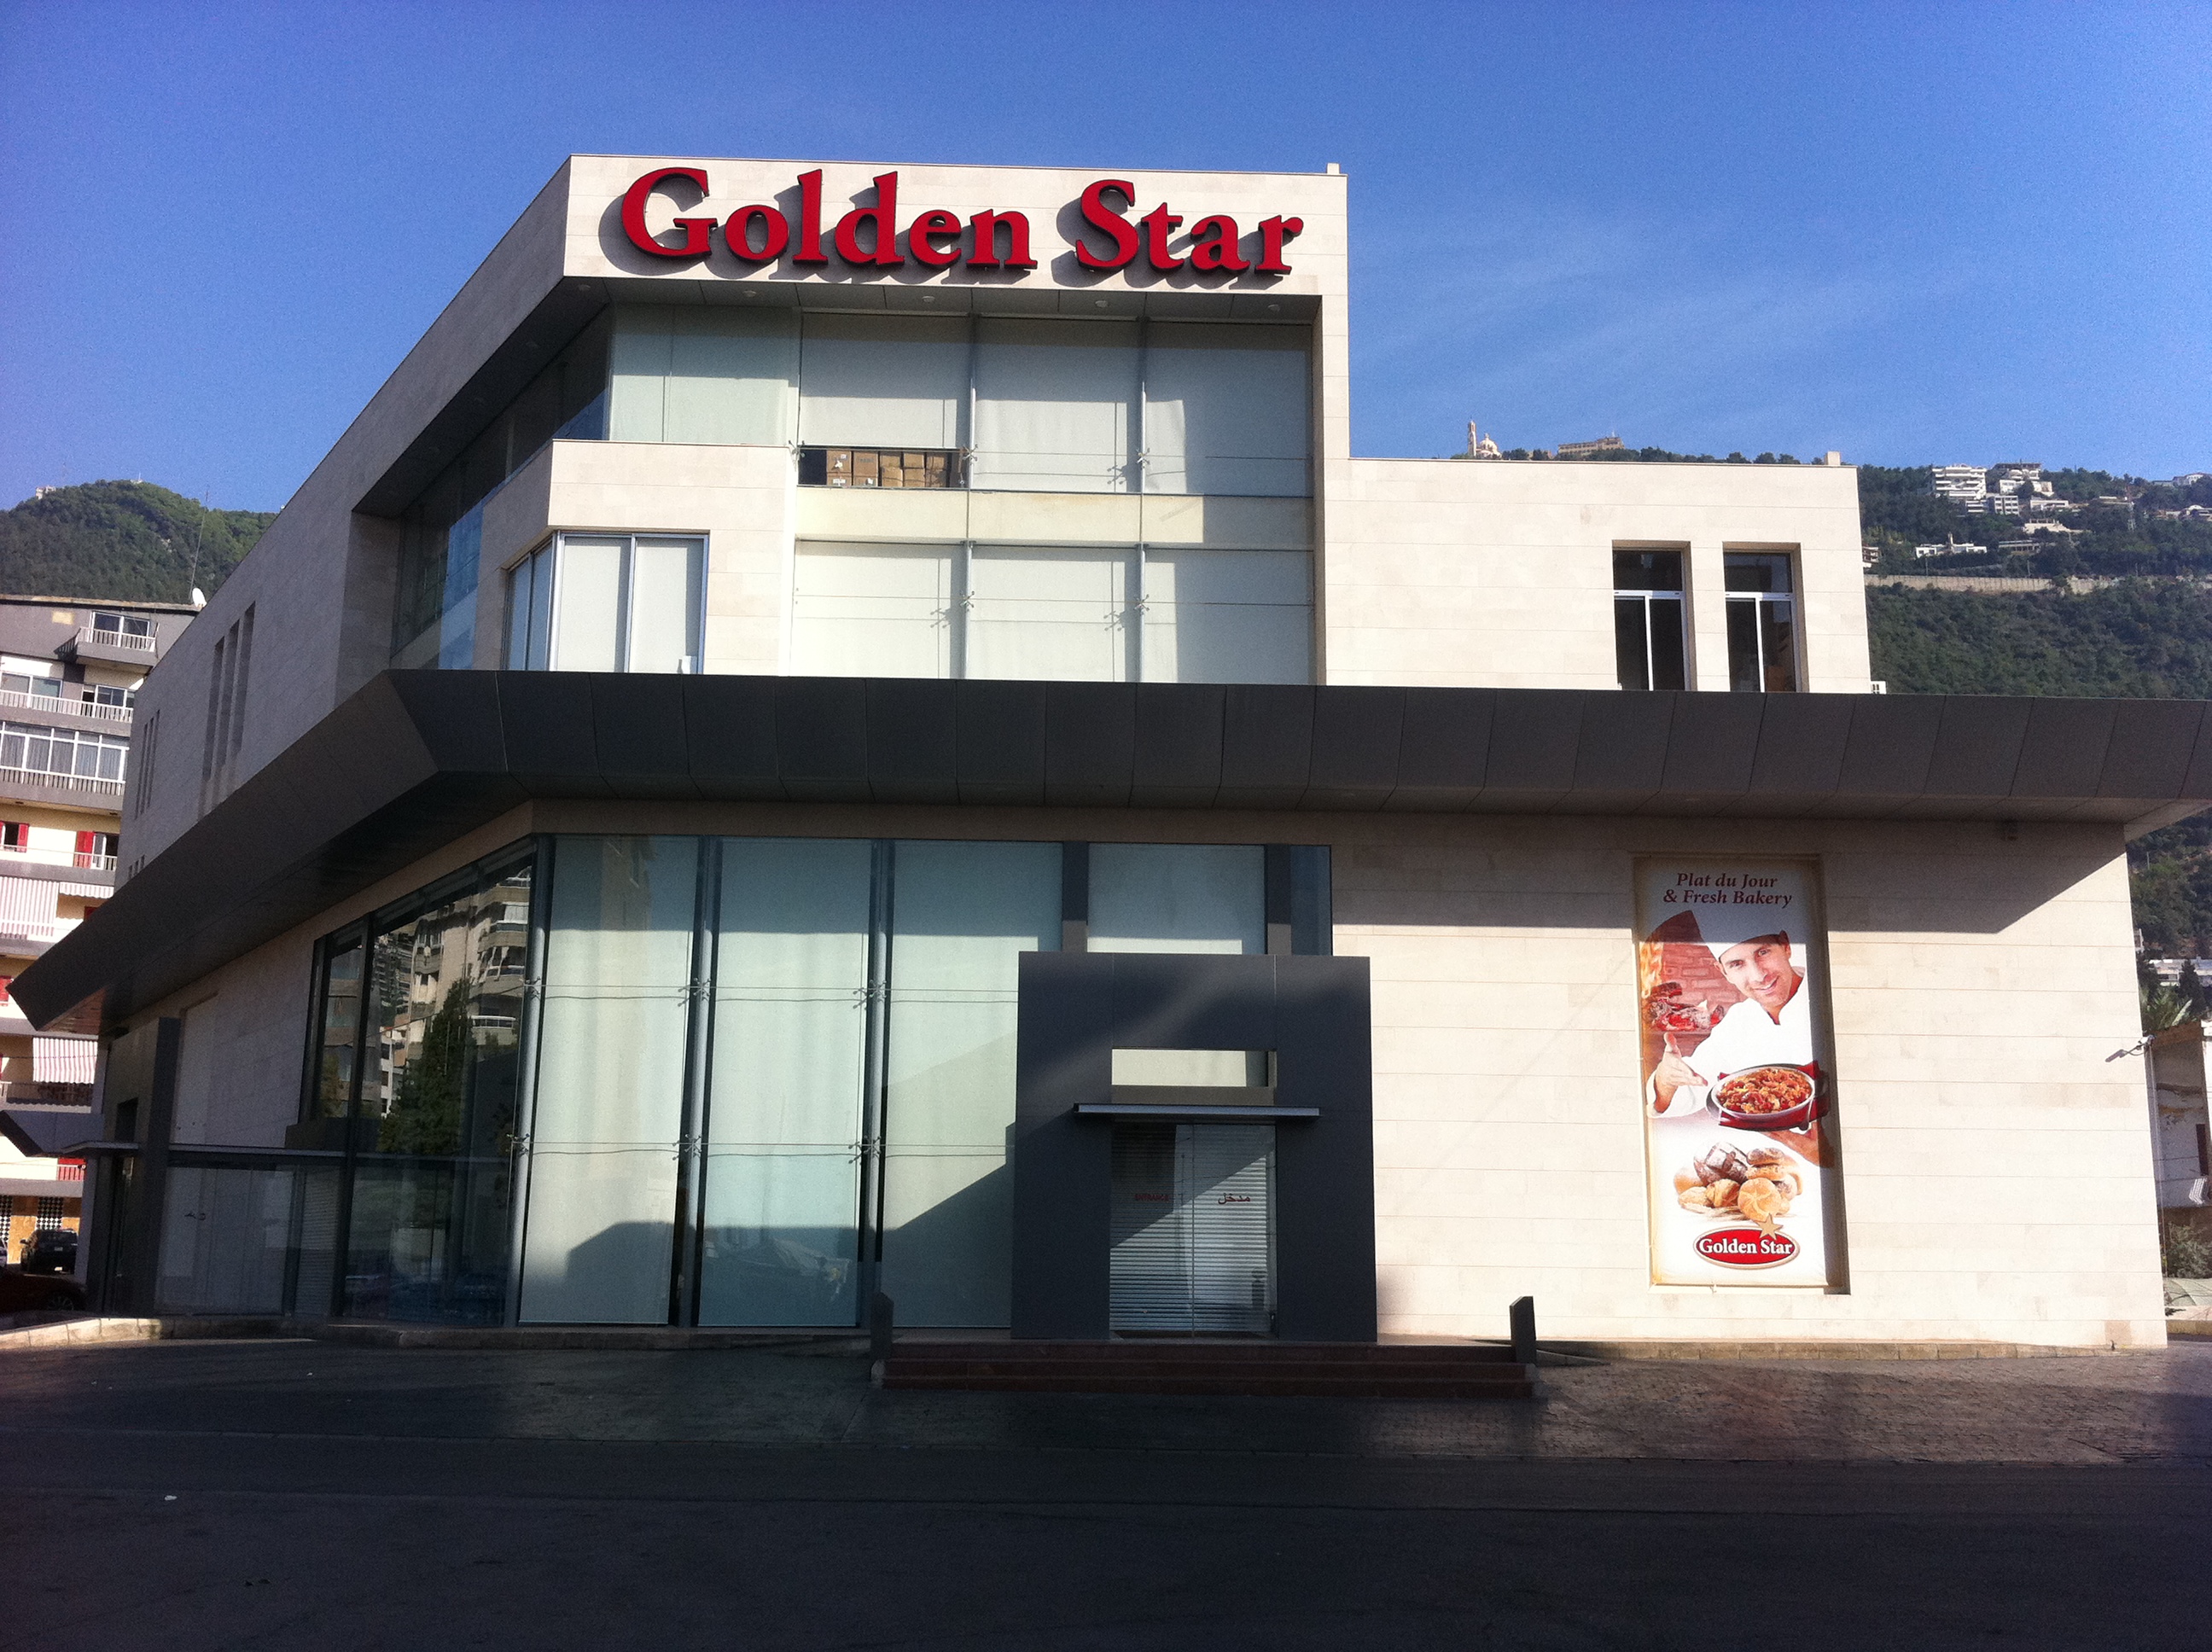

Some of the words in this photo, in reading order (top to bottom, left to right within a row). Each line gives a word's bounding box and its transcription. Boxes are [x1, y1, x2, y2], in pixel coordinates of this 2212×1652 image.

[621, 167, 1038, 270] Golden
[1076, 179, 1304, 274] Star
[1676, 872, 1712, 887] Plat
[1714, 872, 1737, 887] du
[1741, 874, 1778, 889] Jour
[1663, 888, 1678, 903] &
[1683, 889, 1727, 904] Fresh
[1732, 890, 1792, 909] Bakery
[1218, 1192, 1251, 1205] مدخل
[1698, 1237, 1758, 1254] Golden
[1760, 1238, 1793, 1254] Star
